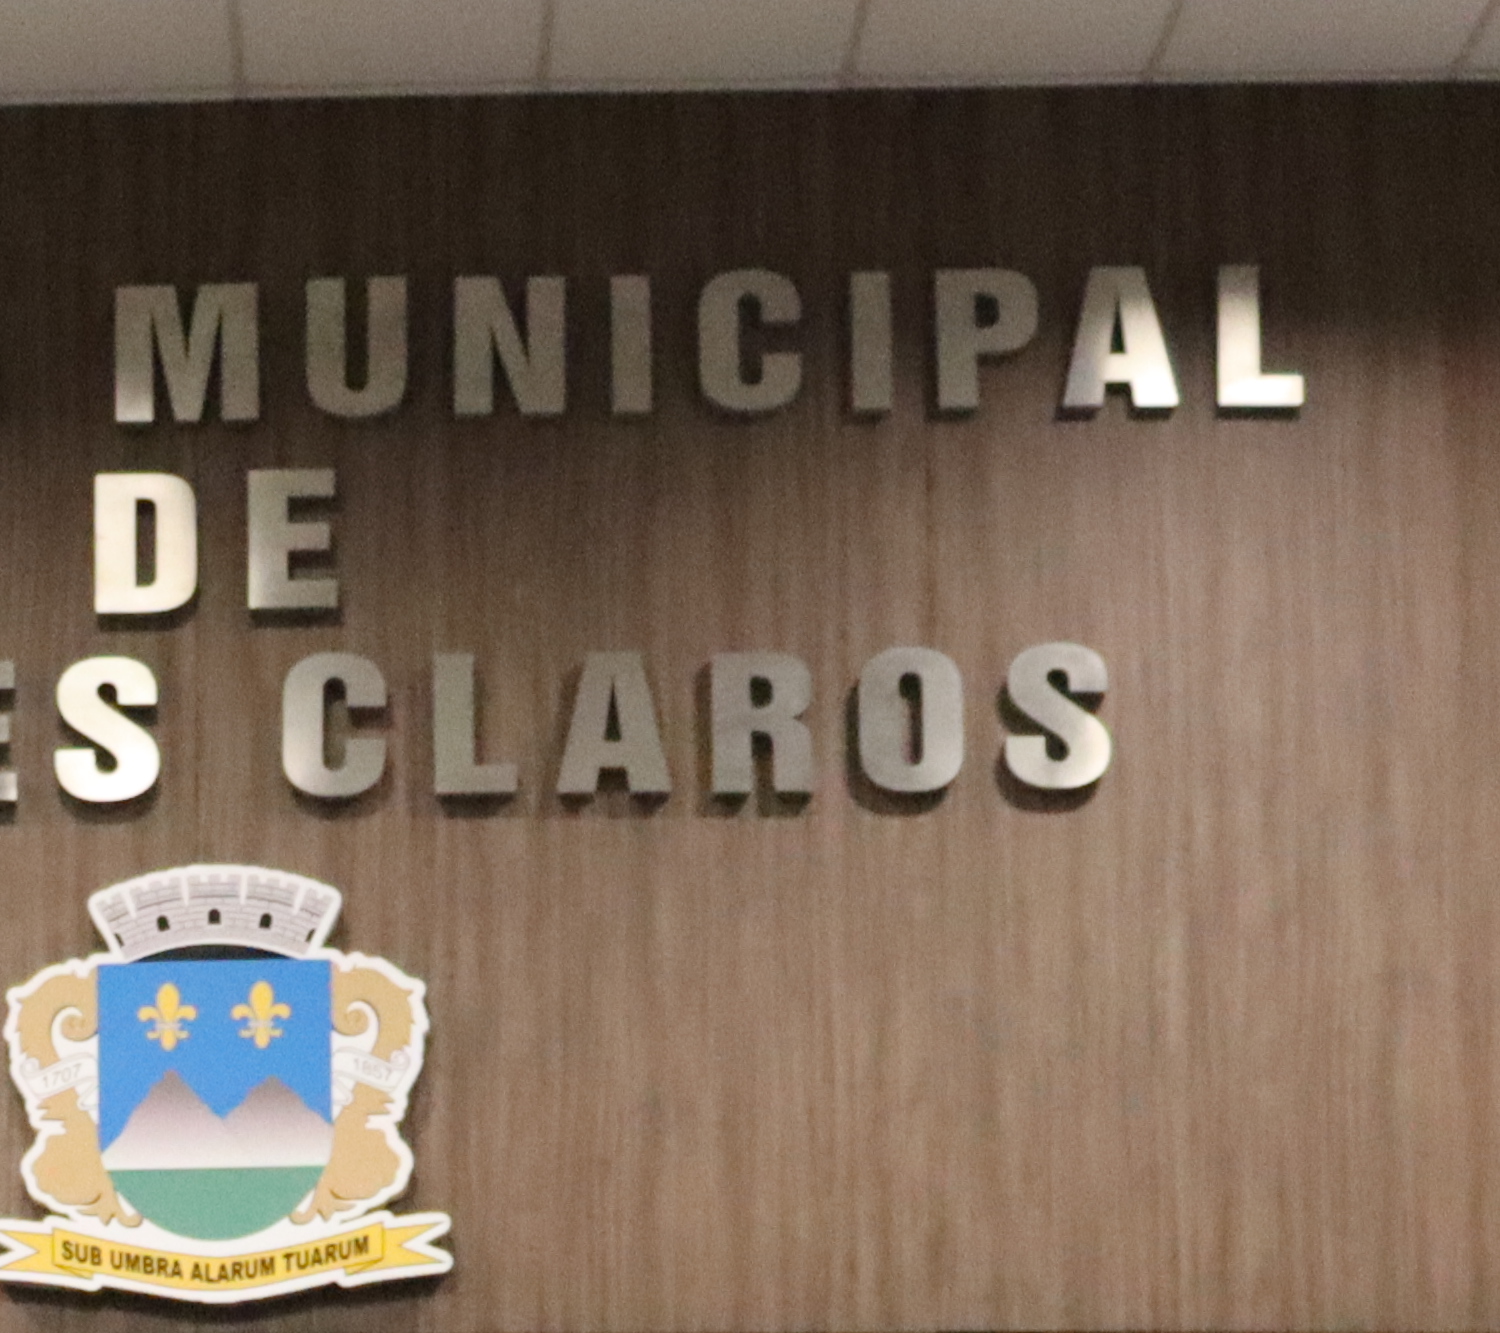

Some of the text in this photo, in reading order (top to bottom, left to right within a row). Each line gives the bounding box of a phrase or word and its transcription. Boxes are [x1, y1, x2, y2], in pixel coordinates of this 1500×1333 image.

[113, 265, 1306, 425] MUNICIPAL
[93, 467, 341, 615] DE
[279, 643, 1113, 802] CLAROS
[61, 1234, 370, 1283] SUB UMBRA ALARUM TUARUM
